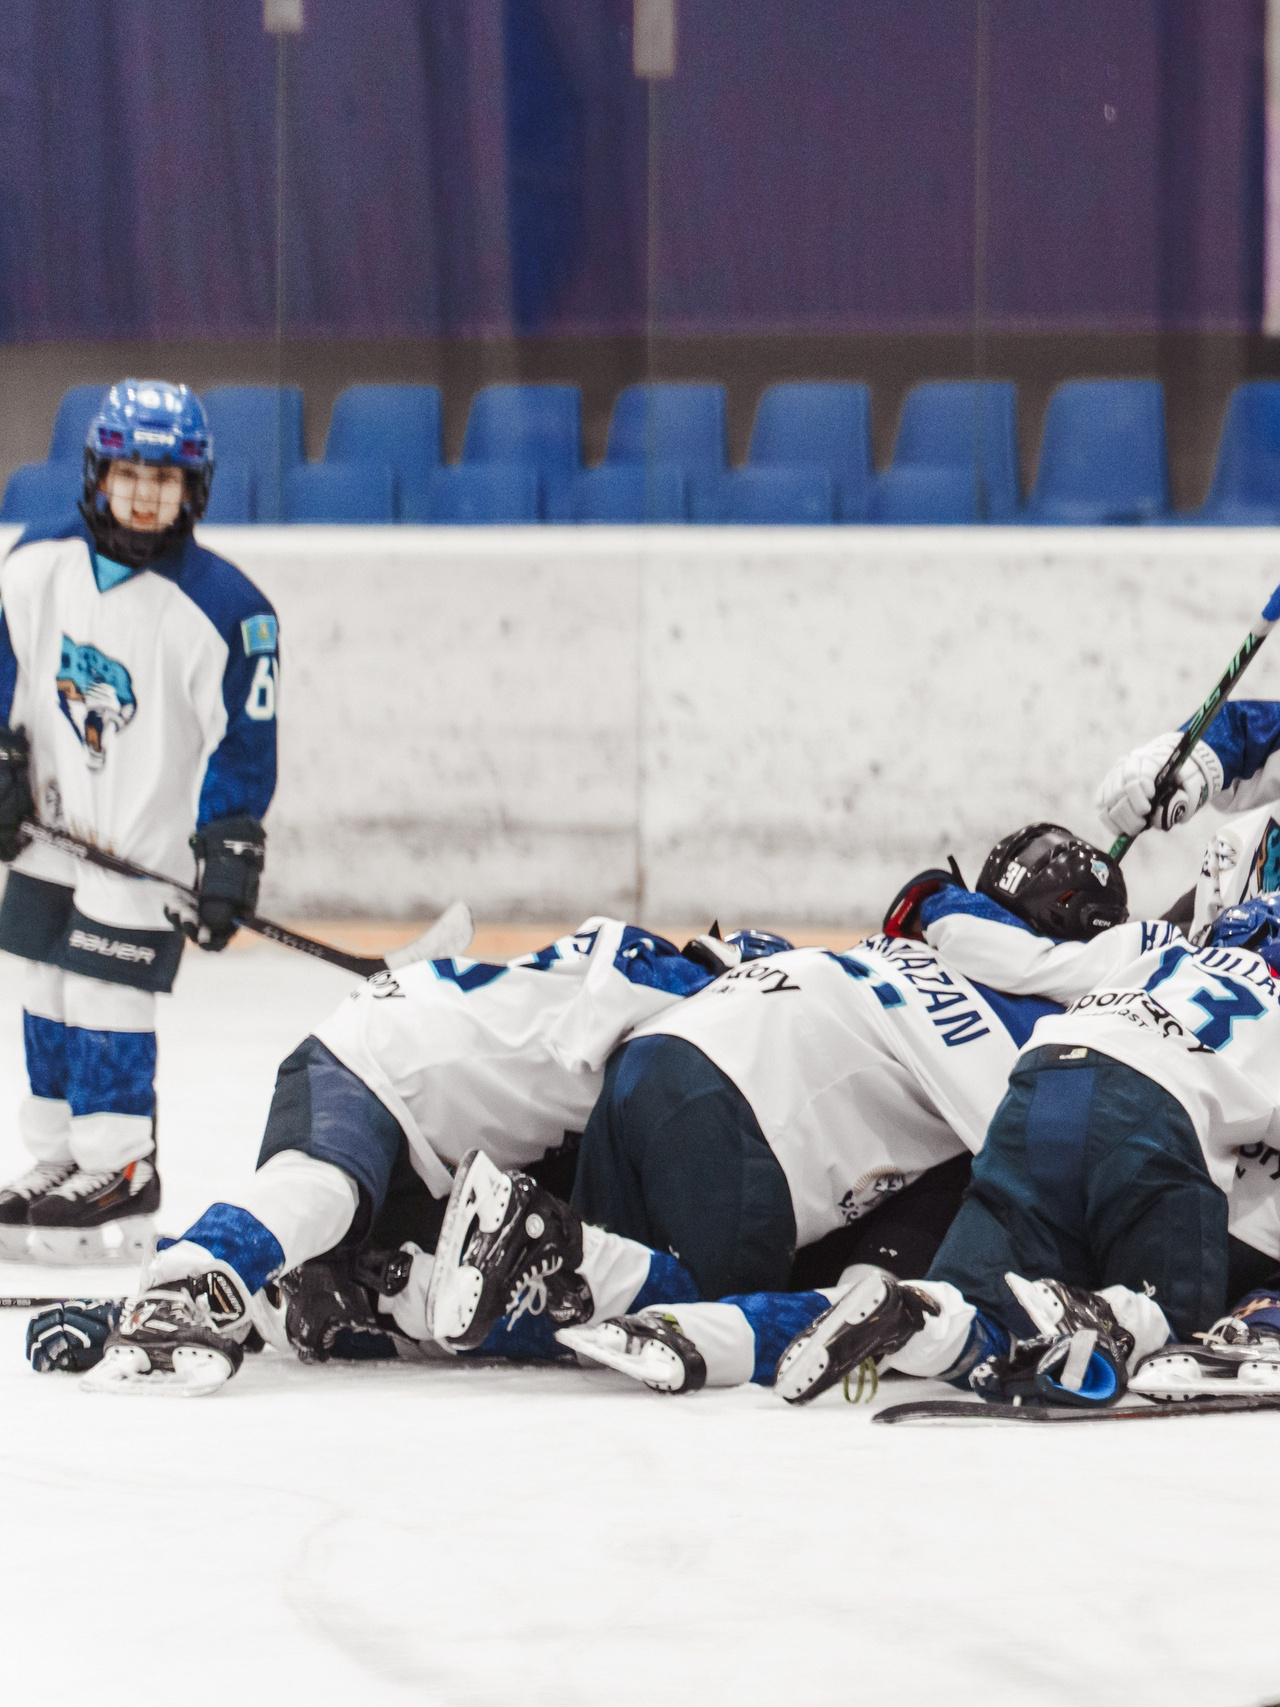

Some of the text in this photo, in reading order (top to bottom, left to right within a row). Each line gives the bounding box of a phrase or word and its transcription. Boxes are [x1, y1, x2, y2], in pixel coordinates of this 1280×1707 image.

[244, 655, 280, 721] 6
[999, 861, 1027, 895] 31
[68, 929, 157, 966] BAUER
